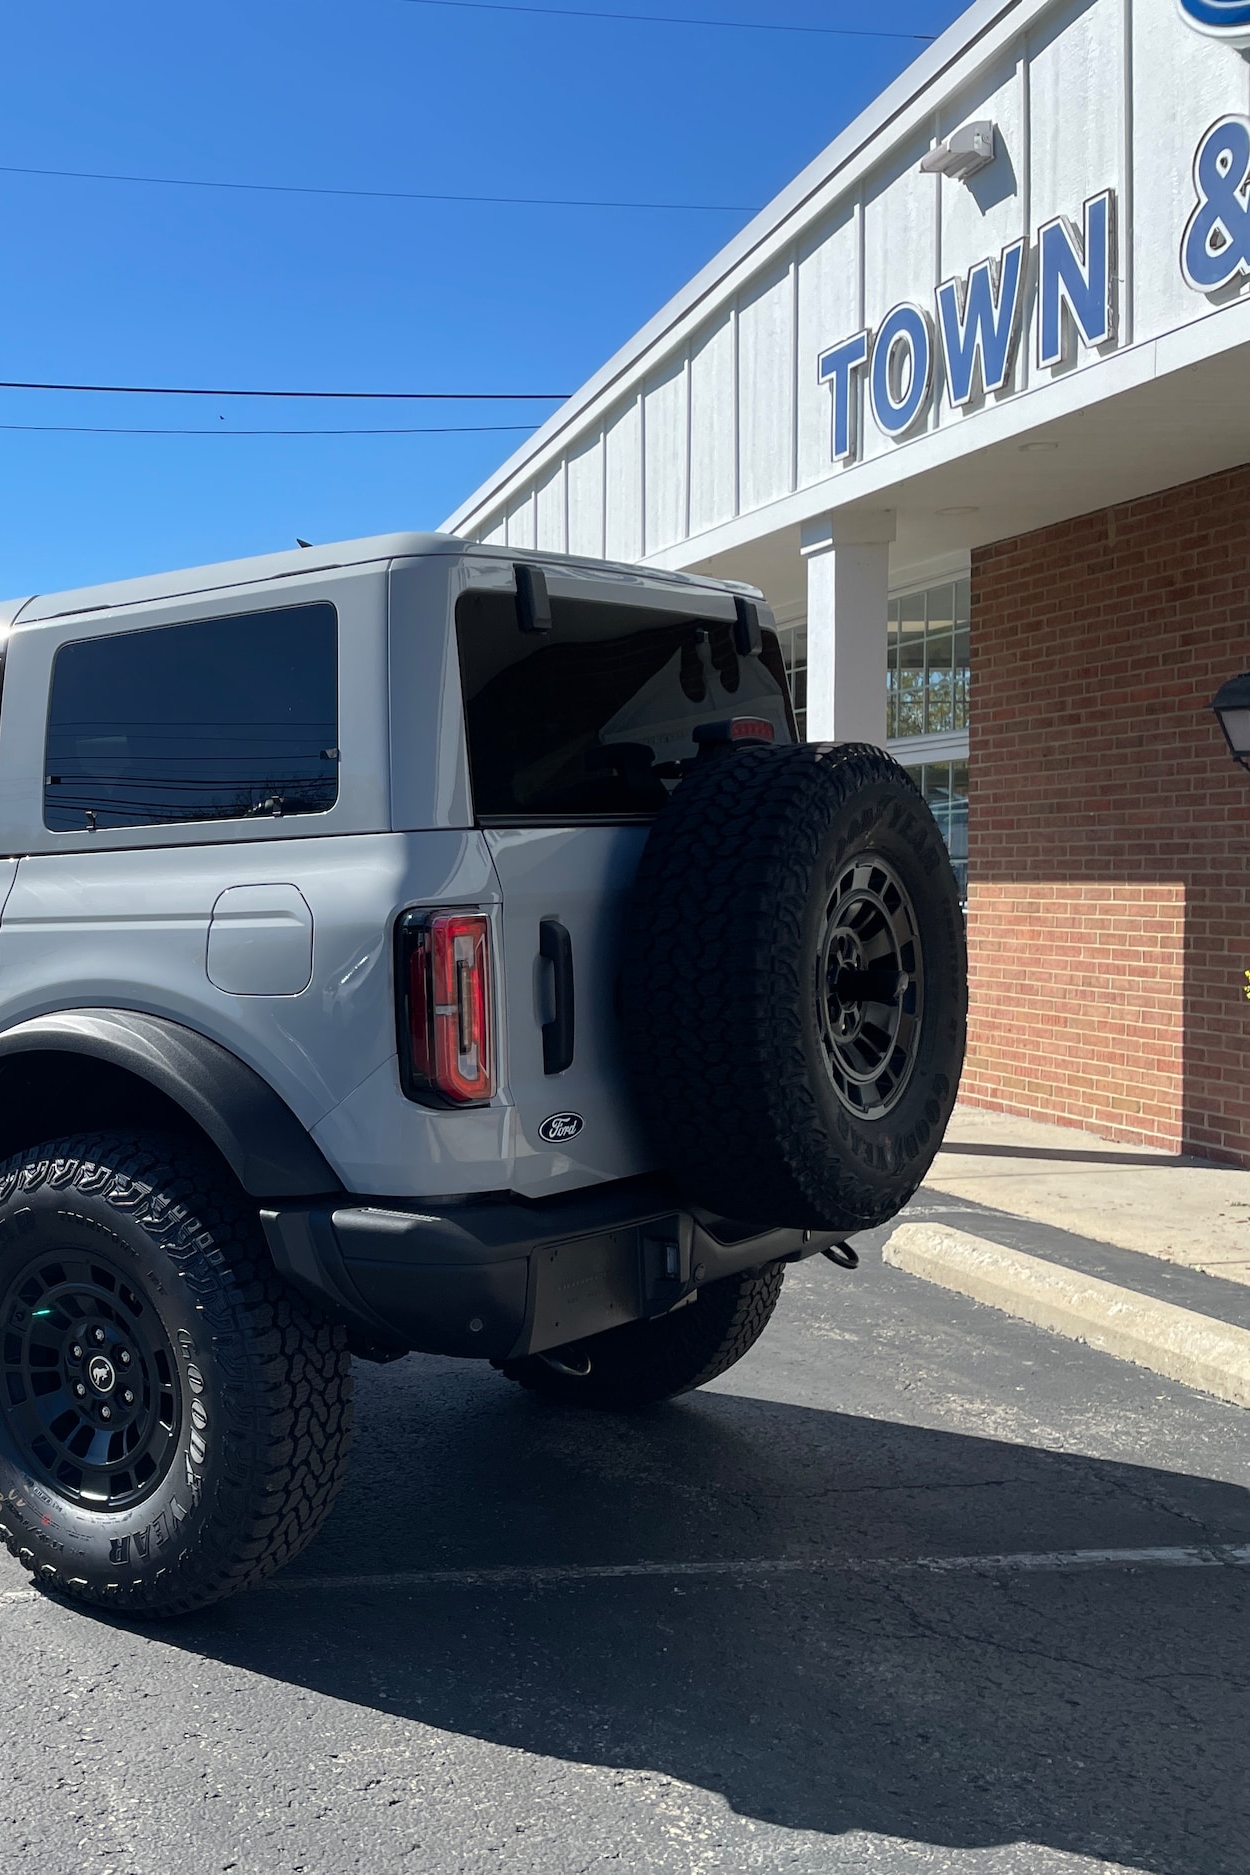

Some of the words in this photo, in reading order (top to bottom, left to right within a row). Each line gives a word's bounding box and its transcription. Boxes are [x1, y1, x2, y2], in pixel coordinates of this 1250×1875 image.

[817, 188, 1116, 462] TOWN
[1180, 114, 1250, 292] &
[549, 1117, 577, 1138] Ford
